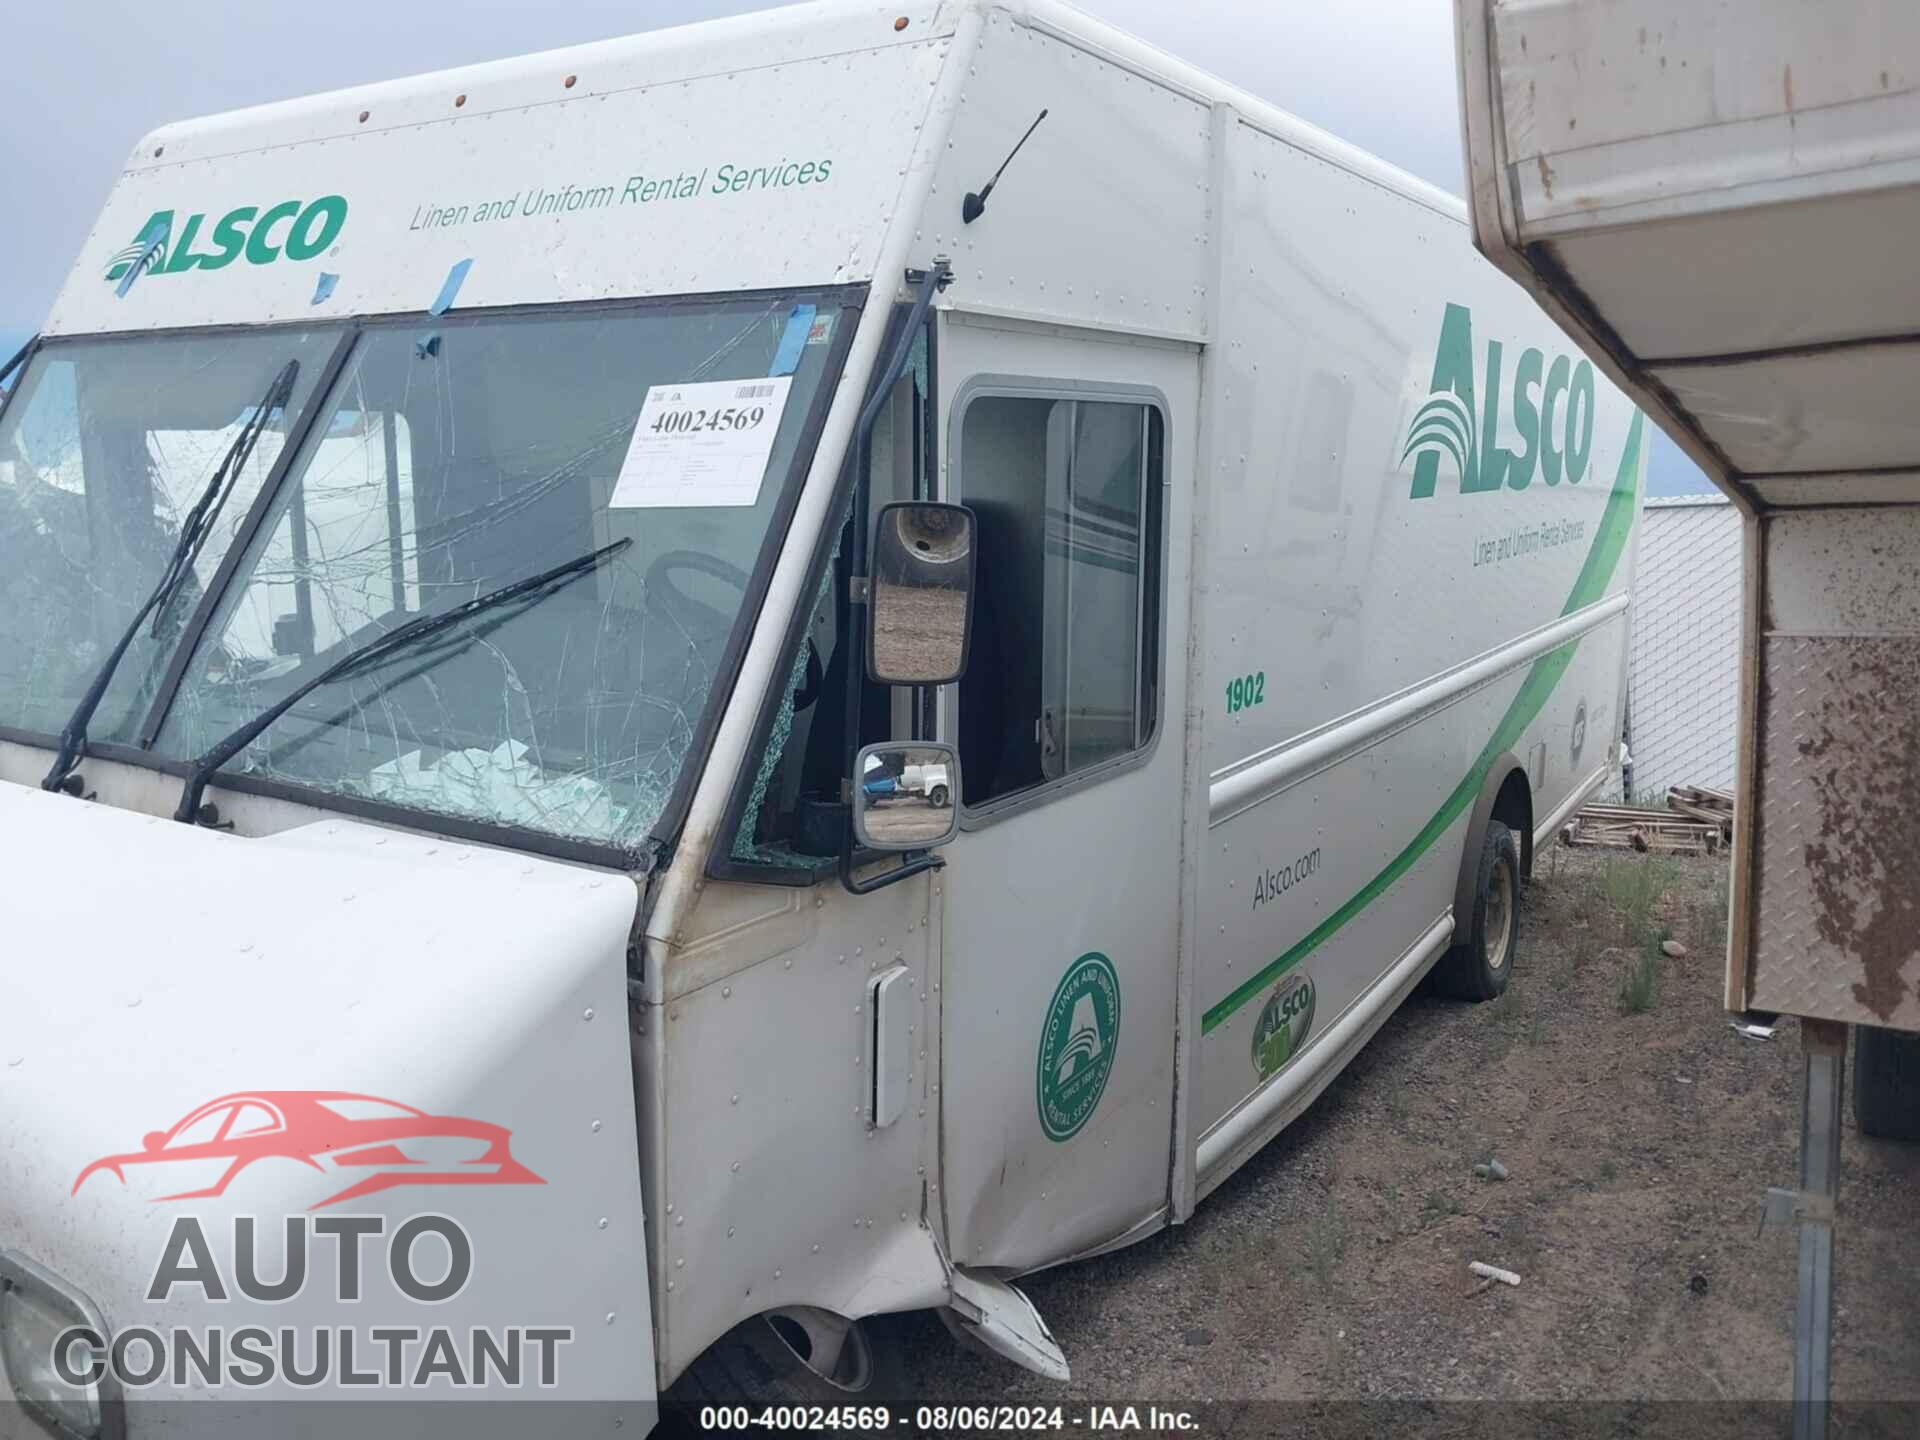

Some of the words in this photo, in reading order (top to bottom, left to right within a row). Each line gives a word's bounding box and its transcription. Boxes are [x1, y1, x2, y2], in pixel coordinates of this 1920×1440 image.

[409, 202, 471, 232] Linen
[472, 192, 520, 224] and
[522, 183, 615, 218] Uniform
[620, 167, 708, 205] Rental
[712, 157, 833, 195] Services
[104, 194, 348, 280] ALSCO
[651, 406, 765, 433] 40024569
[1397, 302, 1595, 499] ALSCO
[1226, 671, 1264, 714] 1902
[1253, 847, 1321, 911] Alsco.com
[1057, 978, 1081, 1016] LINEN
[1262, 983, 1309, 1035] ALSCO
